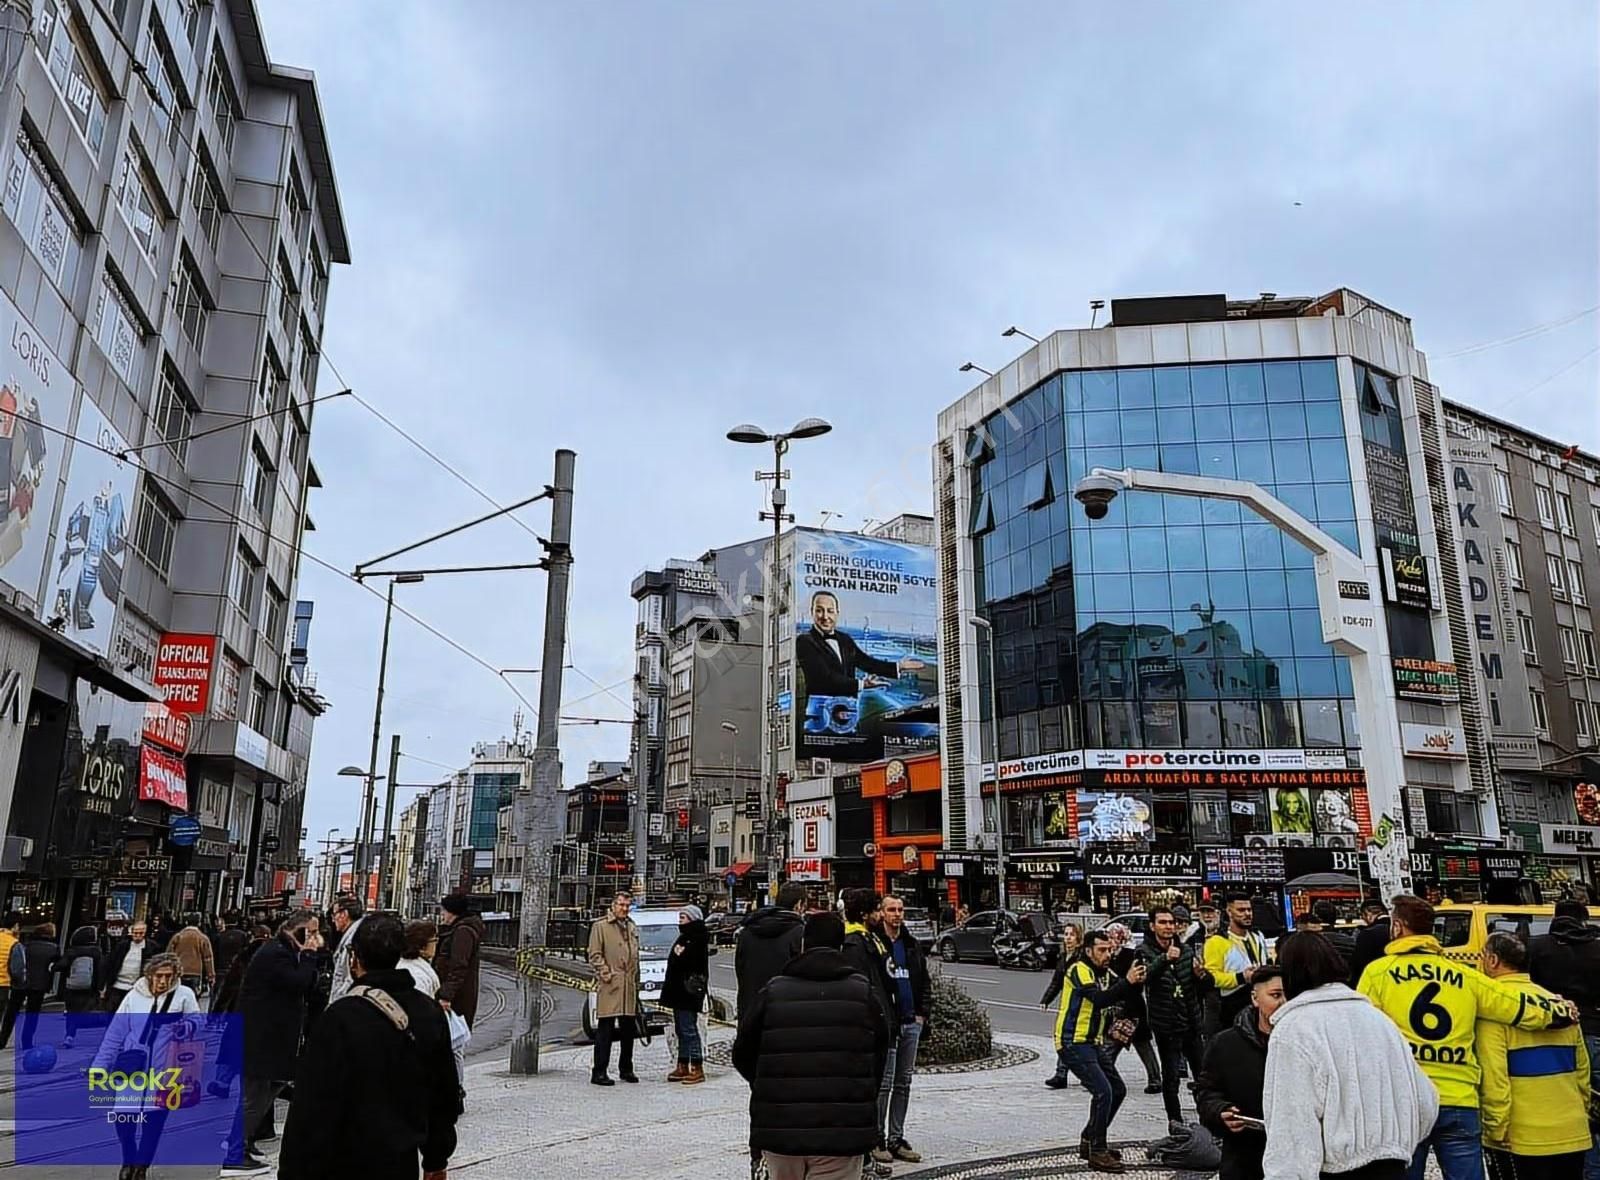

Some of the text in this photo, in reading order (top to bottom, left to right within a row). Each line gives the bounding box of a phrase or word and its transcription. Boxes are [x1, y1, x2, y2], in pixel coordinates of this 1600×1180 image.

[841, 566, 901, 583] TELEKOM
[804, 575, 898, 594] ÇOKTAN HAZIR
[160, 644, 209, 664] OFFICIAL
[158, 666, 208, 680] TRANSLATION
[162, 683, 200, 702] OFFICE
[804, 694, 859, 734] 5G
[1000, 755, 1080, 778] protercüme
[1125, 750, 1261, 768] protercüme
[80, 753, 125, 800] LORIS
[1104, 773, 1141, 783] ARDA
[1145, 770, 1200, 783] KUAFÖR
[1205, 773, 1215, 783] &
[1220, 773, 1247, 786] SAÇ
[1251, 773, 1308, 783] KAYNAK
[795, 804, 827, 820] ECZANE
[1088, 817, 1146, 837] KESİM
[1552, 829, 1593, 846] MELEK
[131, 859, 169, 871] LORIS
[1091, 852, 1192, 866] KARATEKİN
[1389, 962, 1463, 989] KASIM
[1409, 981, 1453, 1041] 6
